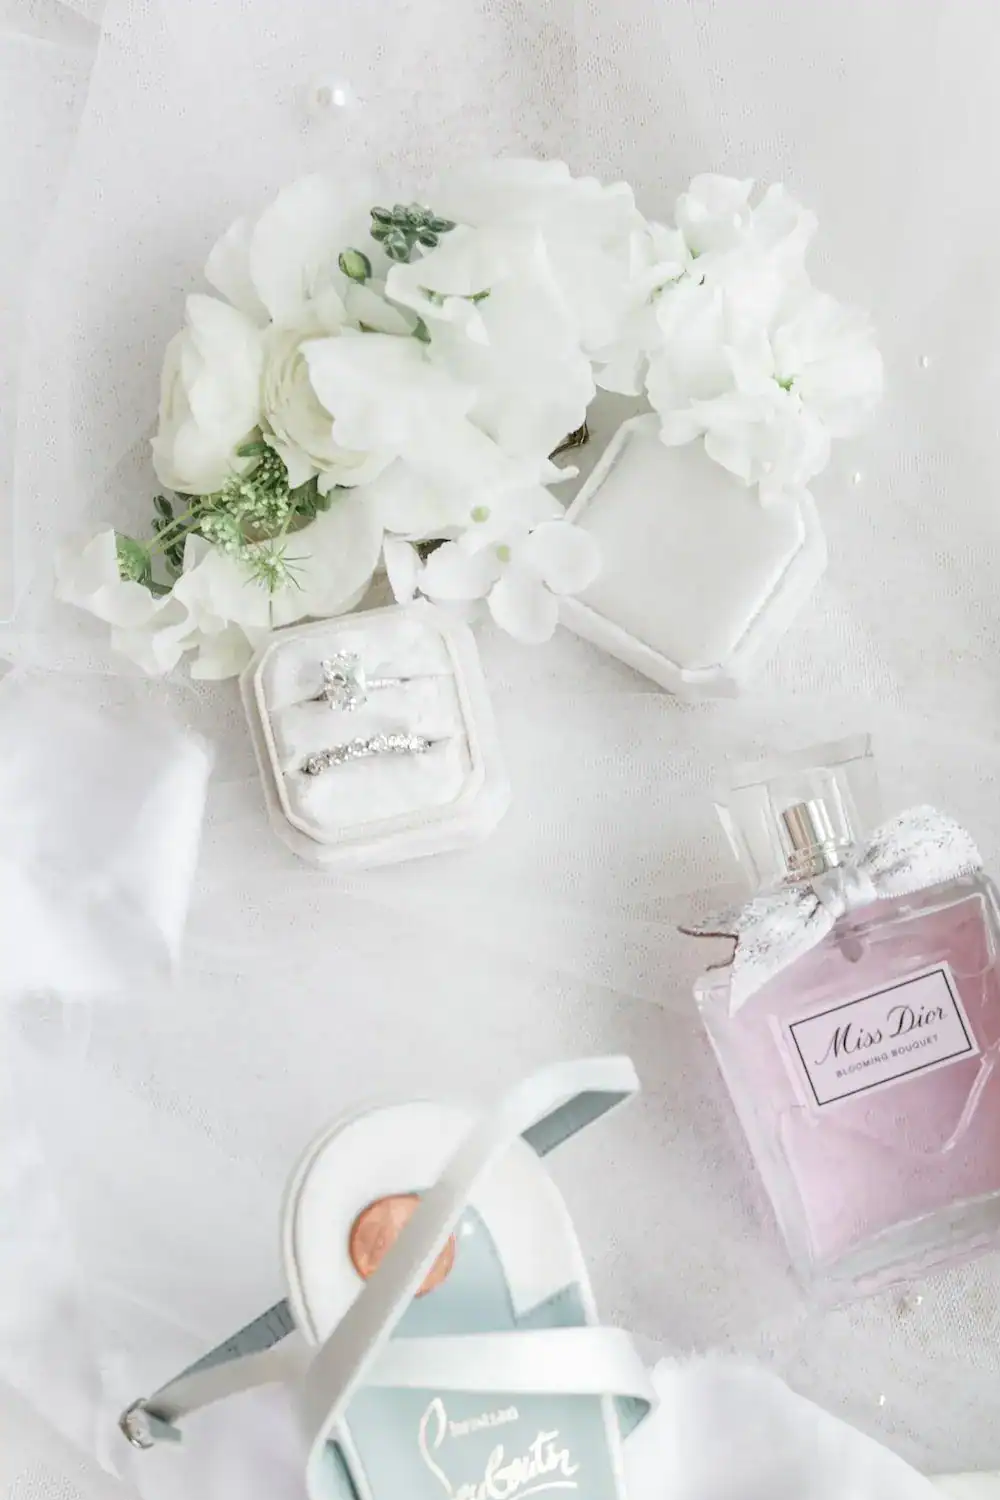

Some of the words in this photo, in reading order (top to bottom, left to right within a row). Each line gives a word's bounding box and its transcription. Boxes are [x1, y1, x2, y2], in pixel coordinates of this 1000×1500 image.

[814, 1022, 883, 1065] Miss
[887, 1004, 948, 1038] Dior
[835, 1053, 889, 1079] BLOOMING
[891, 1033, 940, 1059] BOUQUET
